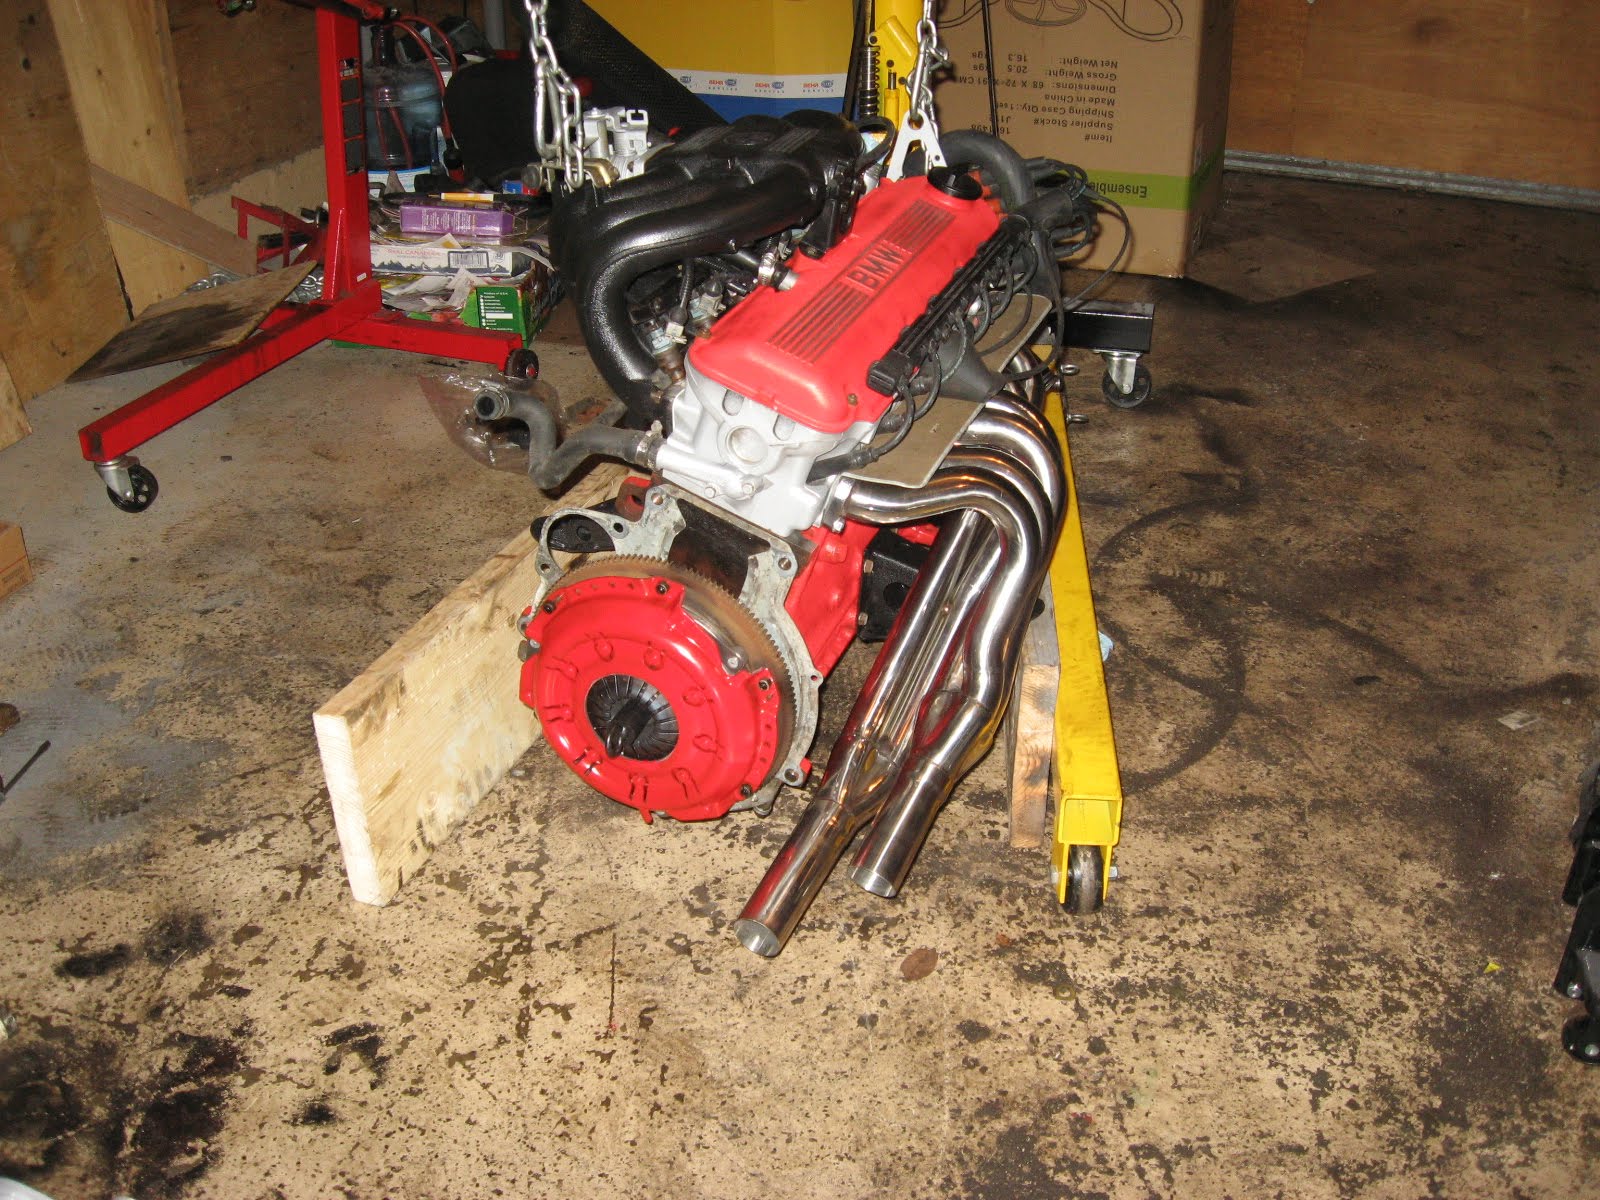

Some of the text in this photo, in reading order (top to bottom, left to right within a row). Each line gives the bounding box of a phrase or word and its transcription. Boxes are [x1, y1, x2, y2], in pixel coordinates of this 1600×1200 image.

[1008, 65, 1027, 73] 20.5
[959, 76, 974, 84] CM
[1087, 72, 1116, 81] Gross
[1053, 82, 1115, 94] Dimensions:
[1044, 94, 1115, 106] Made in China
[1041, 106, 1065, 115] Case
[1069, 106, 1114, 118] Shipping
[1034, 118, 1068, 127] Stock#
[1070, 120, 1113, 130] Supplier
[1085, 134, 1112, 143] Item#
[845, 243, 904, 291] BMW
